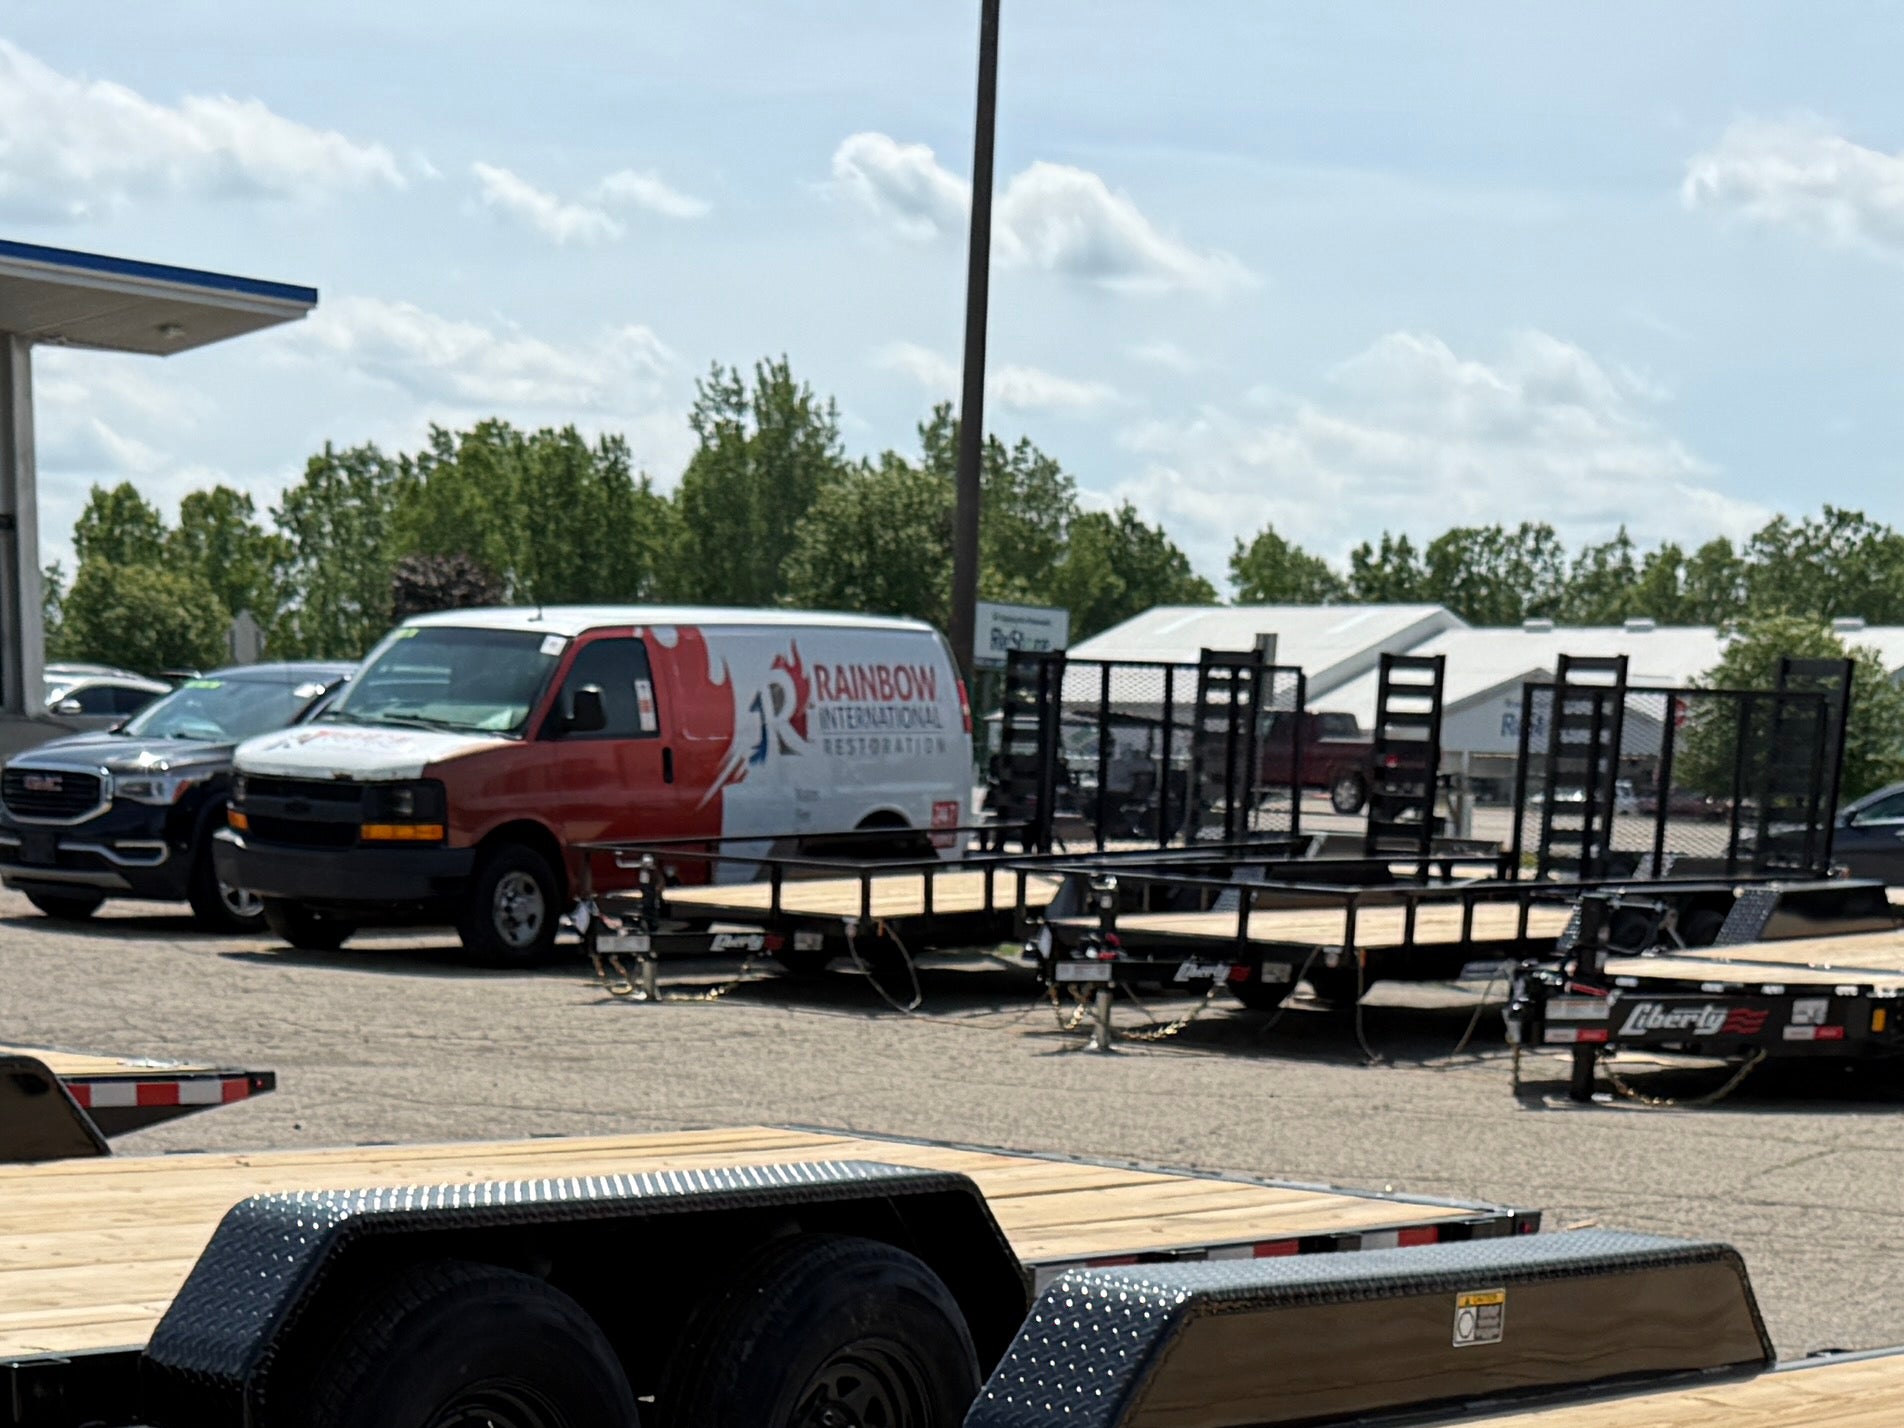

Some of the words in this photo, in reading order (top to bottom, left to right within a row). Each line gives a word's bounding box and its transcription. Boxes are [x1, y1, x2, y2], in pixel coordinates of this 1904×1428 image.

[813, 663, 937, 701] RAINBOW
[818, 705, 944, 729] INTERNATIONAL
[823, 738, 946, 756] RESTORATION
[1618, 1002, 1728, 1036] Liberty
